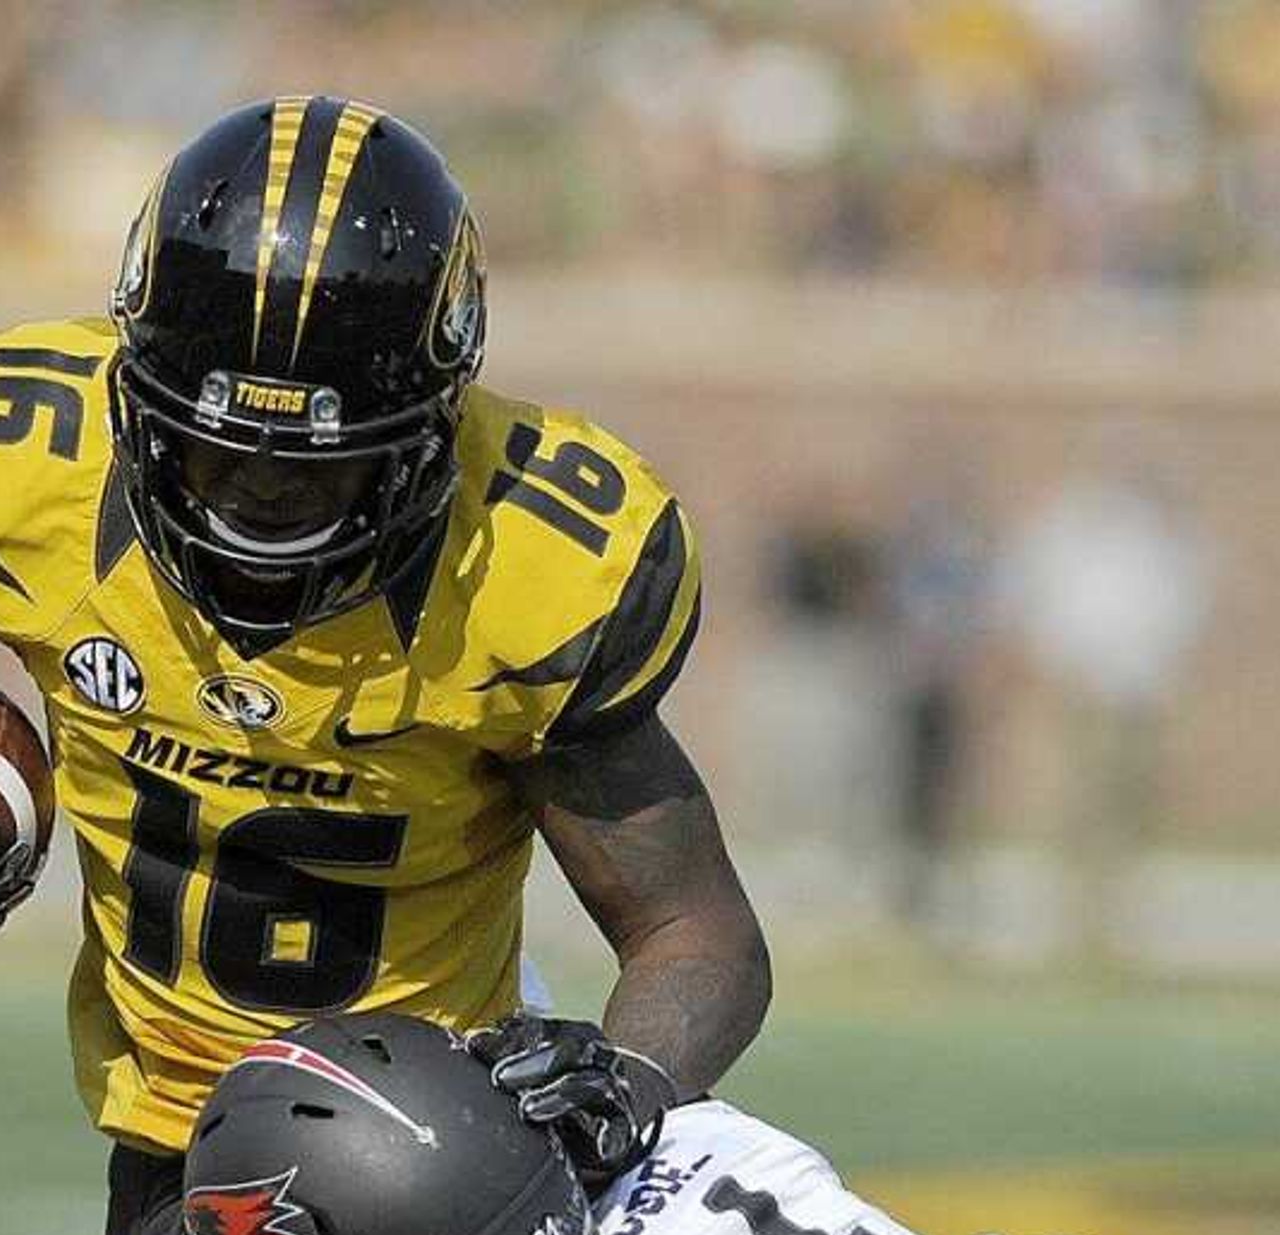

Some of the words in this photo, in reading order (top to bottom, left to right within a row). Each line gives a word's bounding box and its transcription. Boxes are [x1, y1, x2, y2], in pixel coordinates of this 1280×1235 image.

[236, 381, 307, 413] TIGERS
[483, 421, 627, 559] 16
[67, 639, 140, 711] SEC
[123, 727, 357, 797] MIZZOU
[120, 756, 412, 1014] 16
